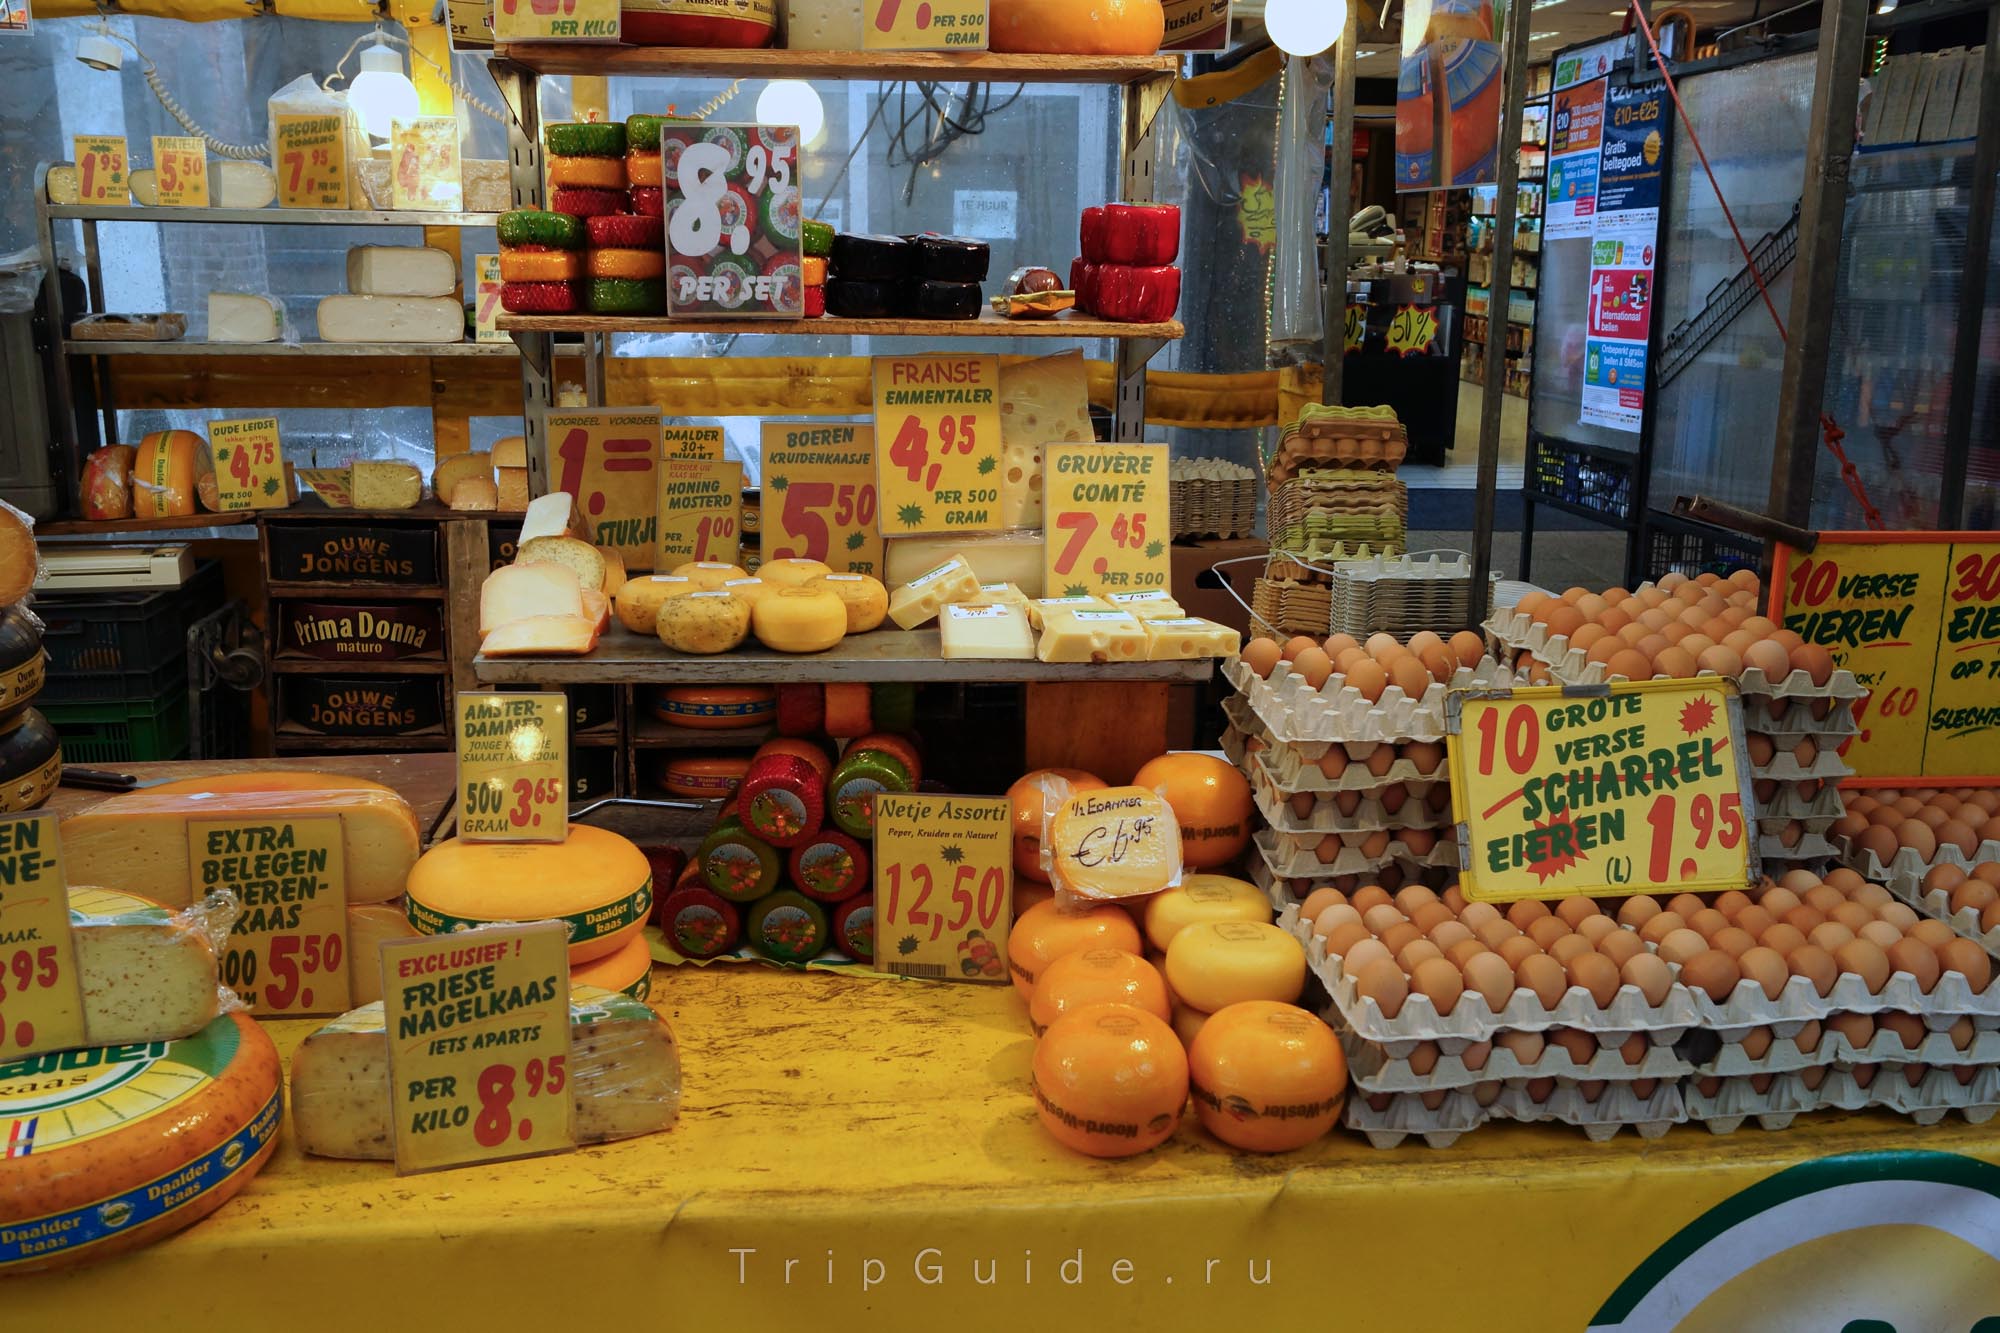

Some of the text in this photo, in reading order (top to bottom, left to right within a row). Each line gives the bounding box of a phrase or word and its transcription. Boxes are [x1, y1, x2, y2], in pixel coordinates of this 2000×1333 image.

[551, 20, 617, 36] PER KILO
[933, 15, 984, 27] PER 500
[945, 32, 979, 44] GRAM
[280, 117, 341, 139] PECORINO
[286, 135, 336, 149] ROMANO
[1605, 140, 1627, 156] Gratis
[1603, 152, 1642, 171] beltegoed
[679, 276, 789, 301] PER SET
[1602, 309, 1641, 321] Internationaal
[1393, 310, 1430, 346] 50%
[1601, 321, 1618, 332] bellen
[1629, 348, 1644, 358] gratis
[892, 361, 982, 385] FRANSE
[886, 388, 993, 405] EMMENTALER
[213, 420, 275, 436] OUDE LEIDSE
[549, 416, 660, 426] VOORDEEL VOORDEEL
[665, 430, 719, 441] DAALDER
[786, 427, 854, 448] BOEREN
[680, 442, 706, 452] 30+
[769, 451, 871, 465] KRUIDENKAASJE
[1056, 451, 1154, 475] GRUYÈRE
[667, 480, 720, 495] HONING
[934, 489, 997, 504] PER 500
[1072, 480, 1146, 502] COMTÉ
[228, 501, 251, 509] GRAM
[669, 495, 732, 510] MOSTERD
[945, 510, 987, 524] GRAM
[323, 536, 391, 556] OUWE
[665, 532, 682, 541] PER
[665, 545, 692, 554] POTJE
[300, 553, 414, 575] JONGENS
[848, 562, 874, 575] PER
[1101, 572, 1164, 586] PER 500
[1790, 558, 1920, 607] 10 VERSE
[294, 611, 427, 649] Prima Donna
[1784, 604, 1914, 648] EIEREN
[336, 641, 383, 653] maturo
[1951, 660, 1983, 680] OP
[328, 690, 395, 709] OUWE
[465, 699, 542, 720] AMSTER-
[311, 703, 416, 726] JONGENS
[1477, 691, 1643, 776] 10 GROTE
[468, 740, 502, 752] JONGE
[1554, 724, 1646, 765] VERSE
[463, 752, 504, 762] SMAAKT
[1523, 737, 1723, 822] SCHARREL
[466, 781, 502, 815] 500
[1087, 797, 1142, 815] EDAMMER
[878, 799, 1007, 823] Netje Assorti
[464, 819, 508, 833] GRAM
[888, 827, 998, 840] Peper, Kruiden en Naturel
[207, 824, 295, 855] EXTRA
[1487, 808, 1625, 873] EIEREN
[202, 848, 327, 885] BELEGEN
[1606, 855, 1632, 885] (L)
[885, 862, 1005, 942] 12,50
[585, 903, 628, 926] Daalder
[596, 917, 622, 935] kaas
[398, 942, 507, 978] EXCLUSIEF
[403, 965, 496, 1011] FRIESE
[398, 976, 558, 1039] NAGELKAAS
[428, 1025, 542, 1056] IETS APARTS
[408, 1076, 456, 1101] PER
[411, 1105, 469, 1134] KILO
[147, 1160, 210, 1201] Daalder
[164, 1181, 201, 1207] kaas
[1, 1217, 81, 1244] Daalder
[20, 1235, 68, 1255] kaas
